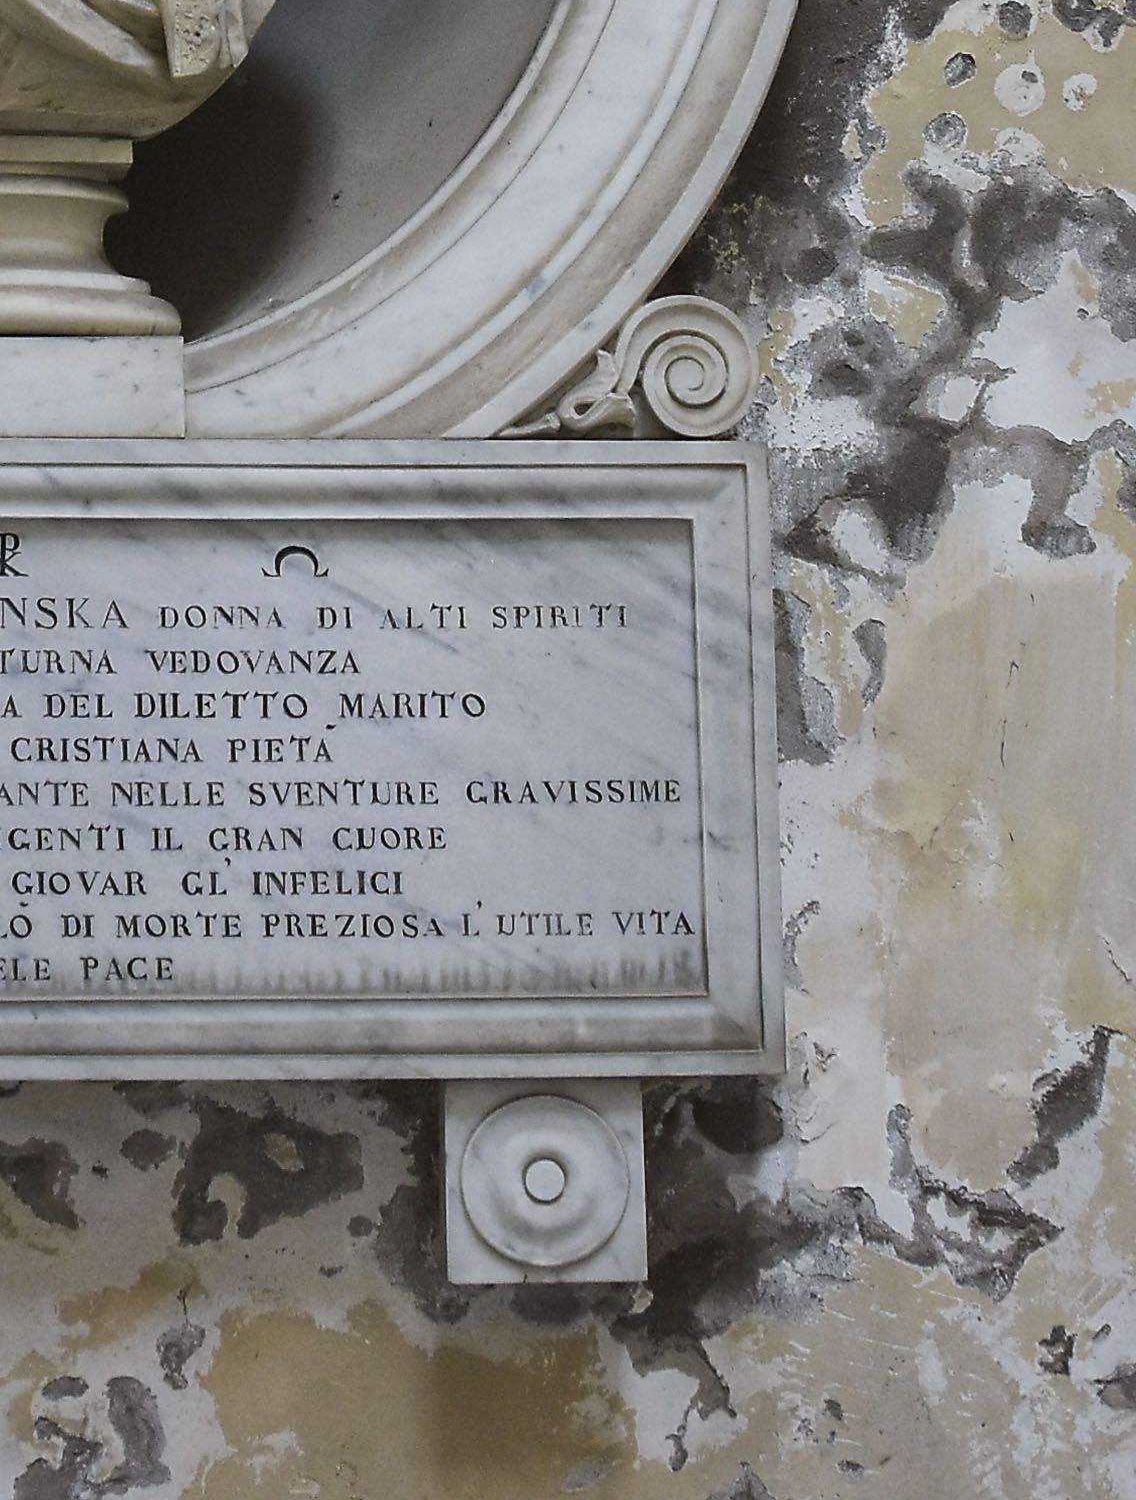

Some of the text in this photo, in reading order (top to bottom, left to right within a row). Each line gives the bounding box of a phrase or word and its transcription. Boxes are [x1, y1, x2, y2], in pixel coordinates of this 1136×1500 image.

[157, 604, 287, 630] DONNA
[316, 605, 353, 630] DI
[378, 603, 469, 630] ALTI
[491, 603, 628, 630] SPIRITI
[145, 649, 361, 675] VEDOVANZA
[42, 693, 113, 719] DEL
[133, 690, 308, 719] DILETTO
[338, 690, 487, 719] MARITO
[10, 736, 203, 763] CRISTIANA
[110, 780, 226, 807] NELLE
[248, 777, 440, 807] SVENTURE
[465, 779, 682, 805] GRAVISSIME
[150, 827, 183, 852] IL
[207, 827, 304, 852] GRAN
[332, 826, 448, 851] CUORE
[11, 870, 148, 897] GIOVAR
[61, 913, 95, 940] DI
[115, 912, 243, 940] MORTE
[260, 912, 445, 940] PREZIOSA
[614, 910, 696, 937] VITA
[80, 956, 175, 982] PACE
